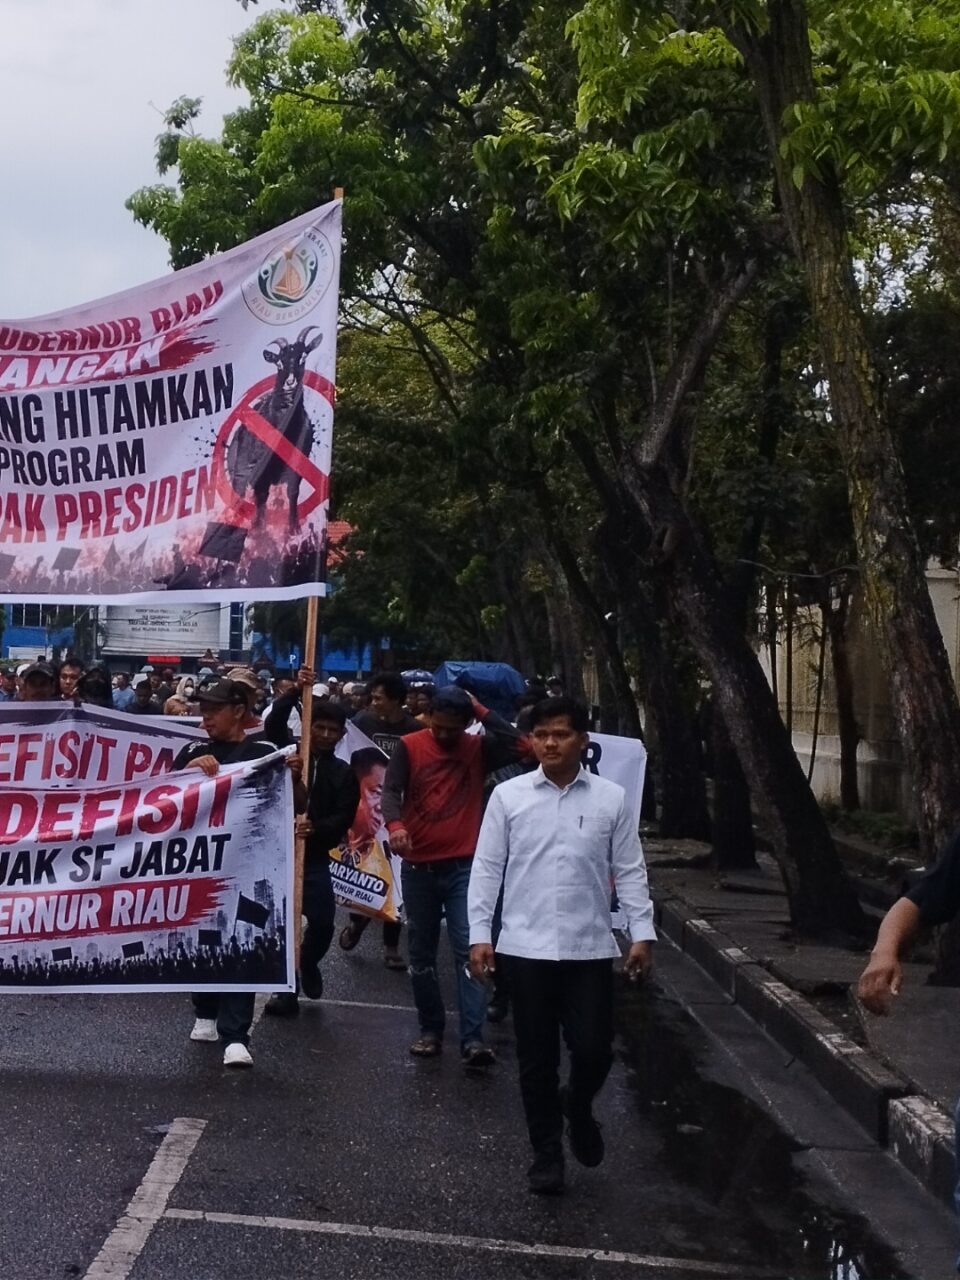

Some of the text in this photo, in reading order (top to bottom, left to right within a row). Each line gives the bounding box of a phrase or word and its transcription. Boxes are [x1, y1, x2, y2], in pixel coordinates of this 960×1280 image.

[149, 280, 224, 333] RIAU
[54, 362, 235, 440] HITAMKAN
[54, 464, 220, 541] PRESIDEN
[124, 741, 174, 780] PA
[120, 833, 232, 879] JABAT
[110, 883, 191, 927] RIAU
